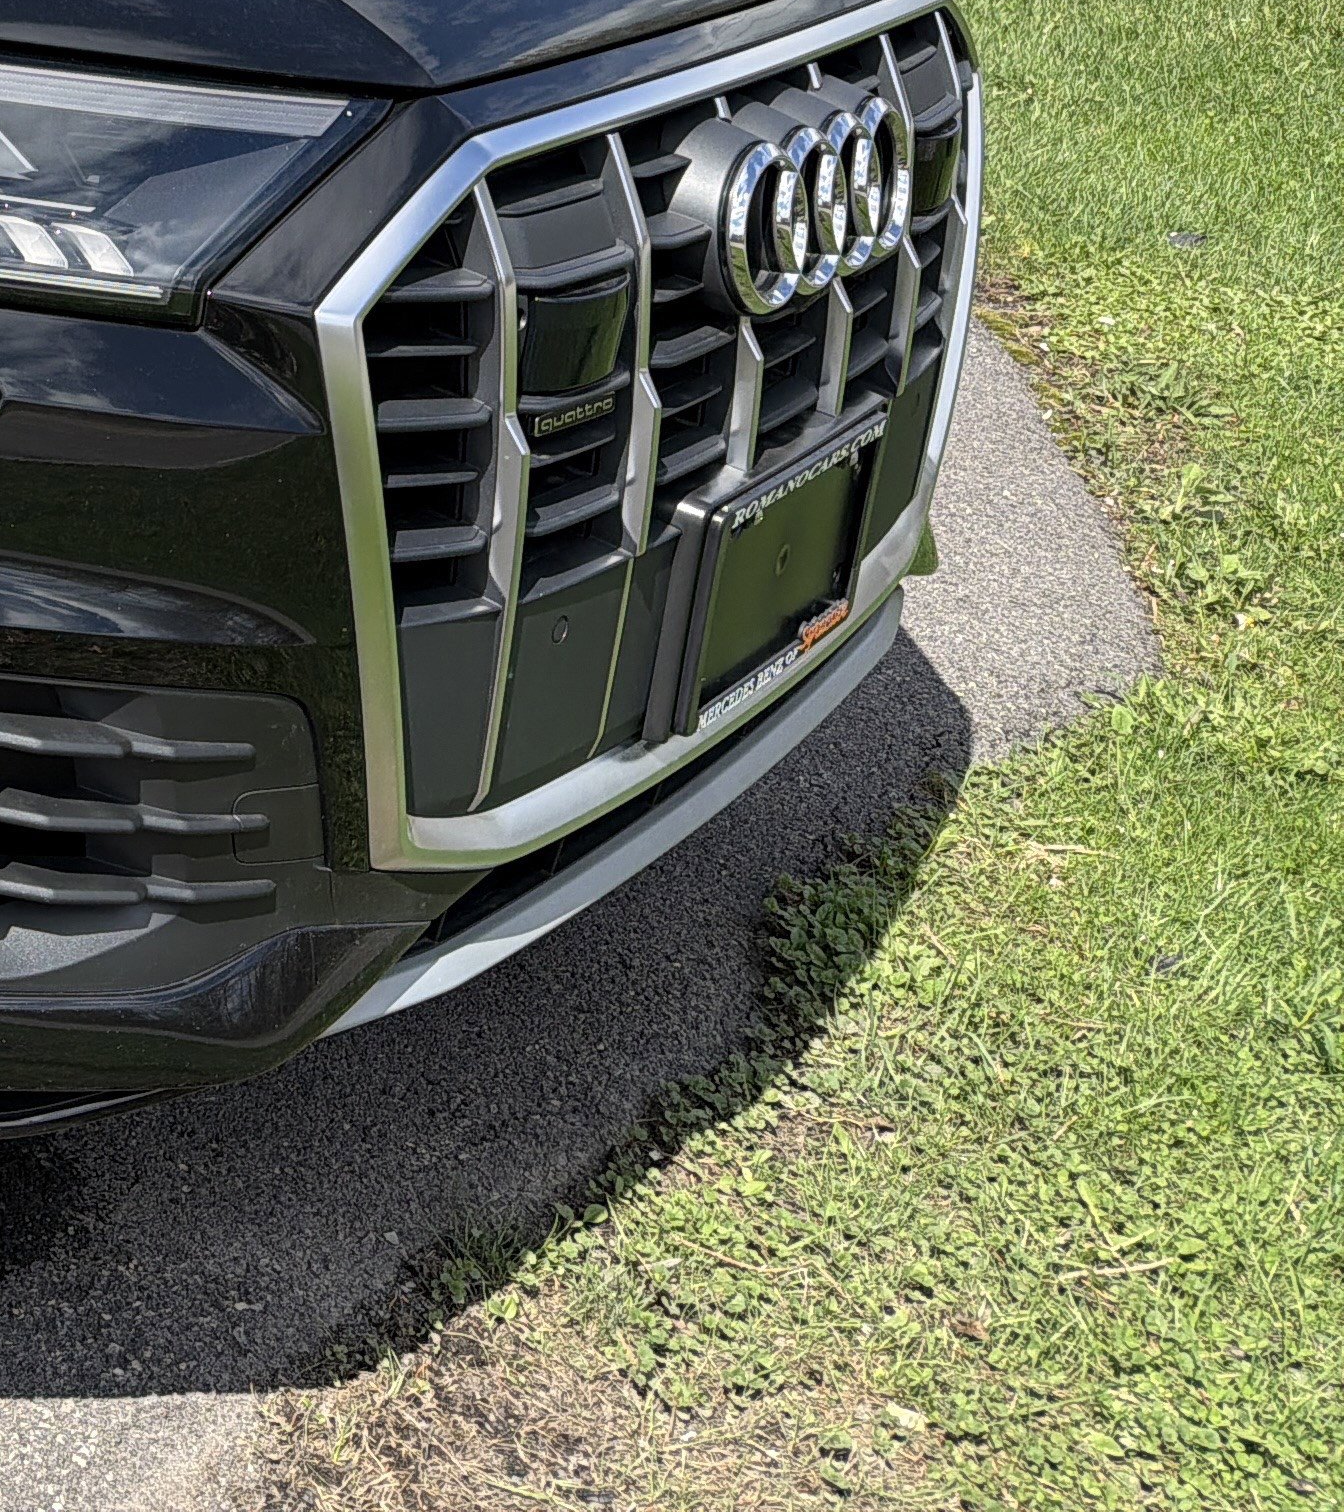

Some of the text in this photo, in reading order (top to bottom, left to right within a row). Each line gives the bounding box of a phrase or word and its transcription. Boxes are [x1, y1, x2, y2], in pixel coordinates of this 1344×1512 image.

[540, 396, 613, 432] quattro
[697, 677, 756, 731] MERCEDES
[755, 656, 785, 692] BENZ
